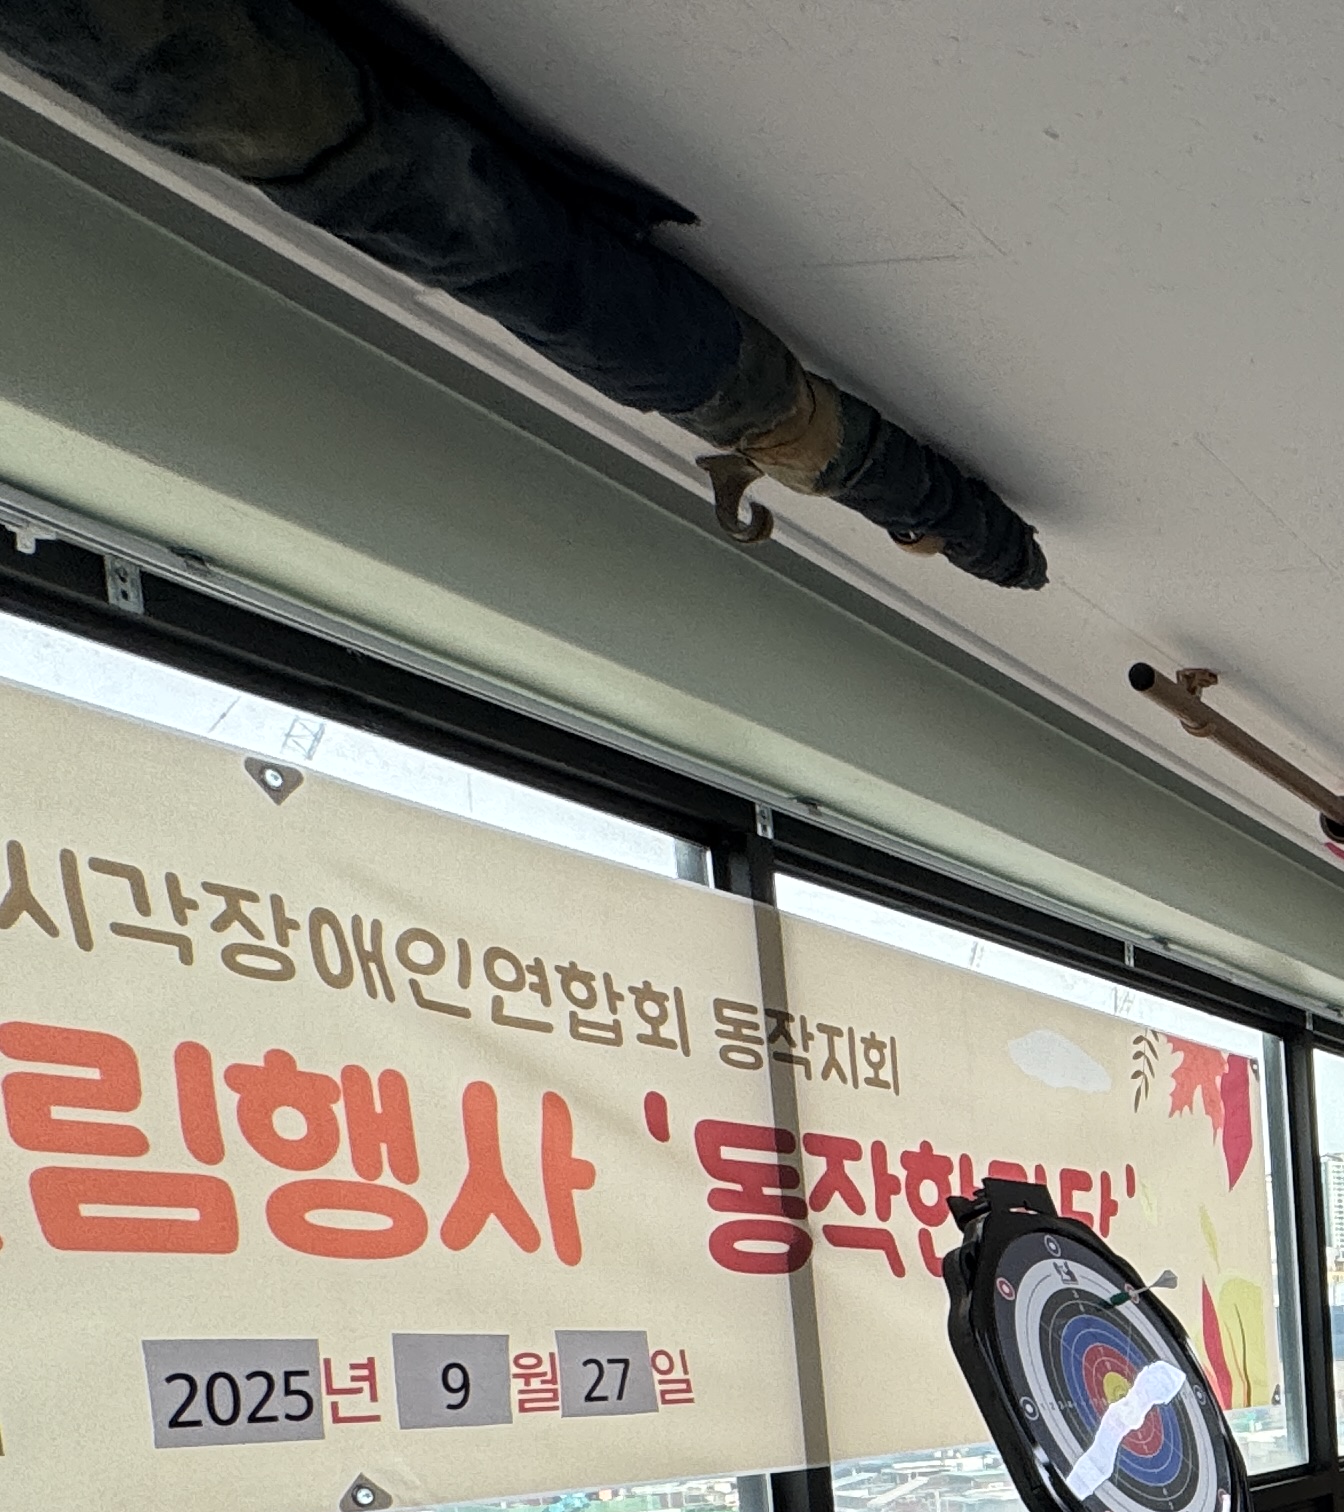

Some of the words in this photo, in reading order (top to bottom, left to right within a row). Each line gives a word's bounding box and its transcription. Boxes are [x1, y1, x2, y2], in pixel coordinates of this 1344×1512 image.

[0, 840, 691, 1057] 시각장애인연합회
[713, 997, 900, 1095] 동작지회
[0, 1020, 596, 1267] 림행사
[163, 1356, 382, 1429] 2025년
